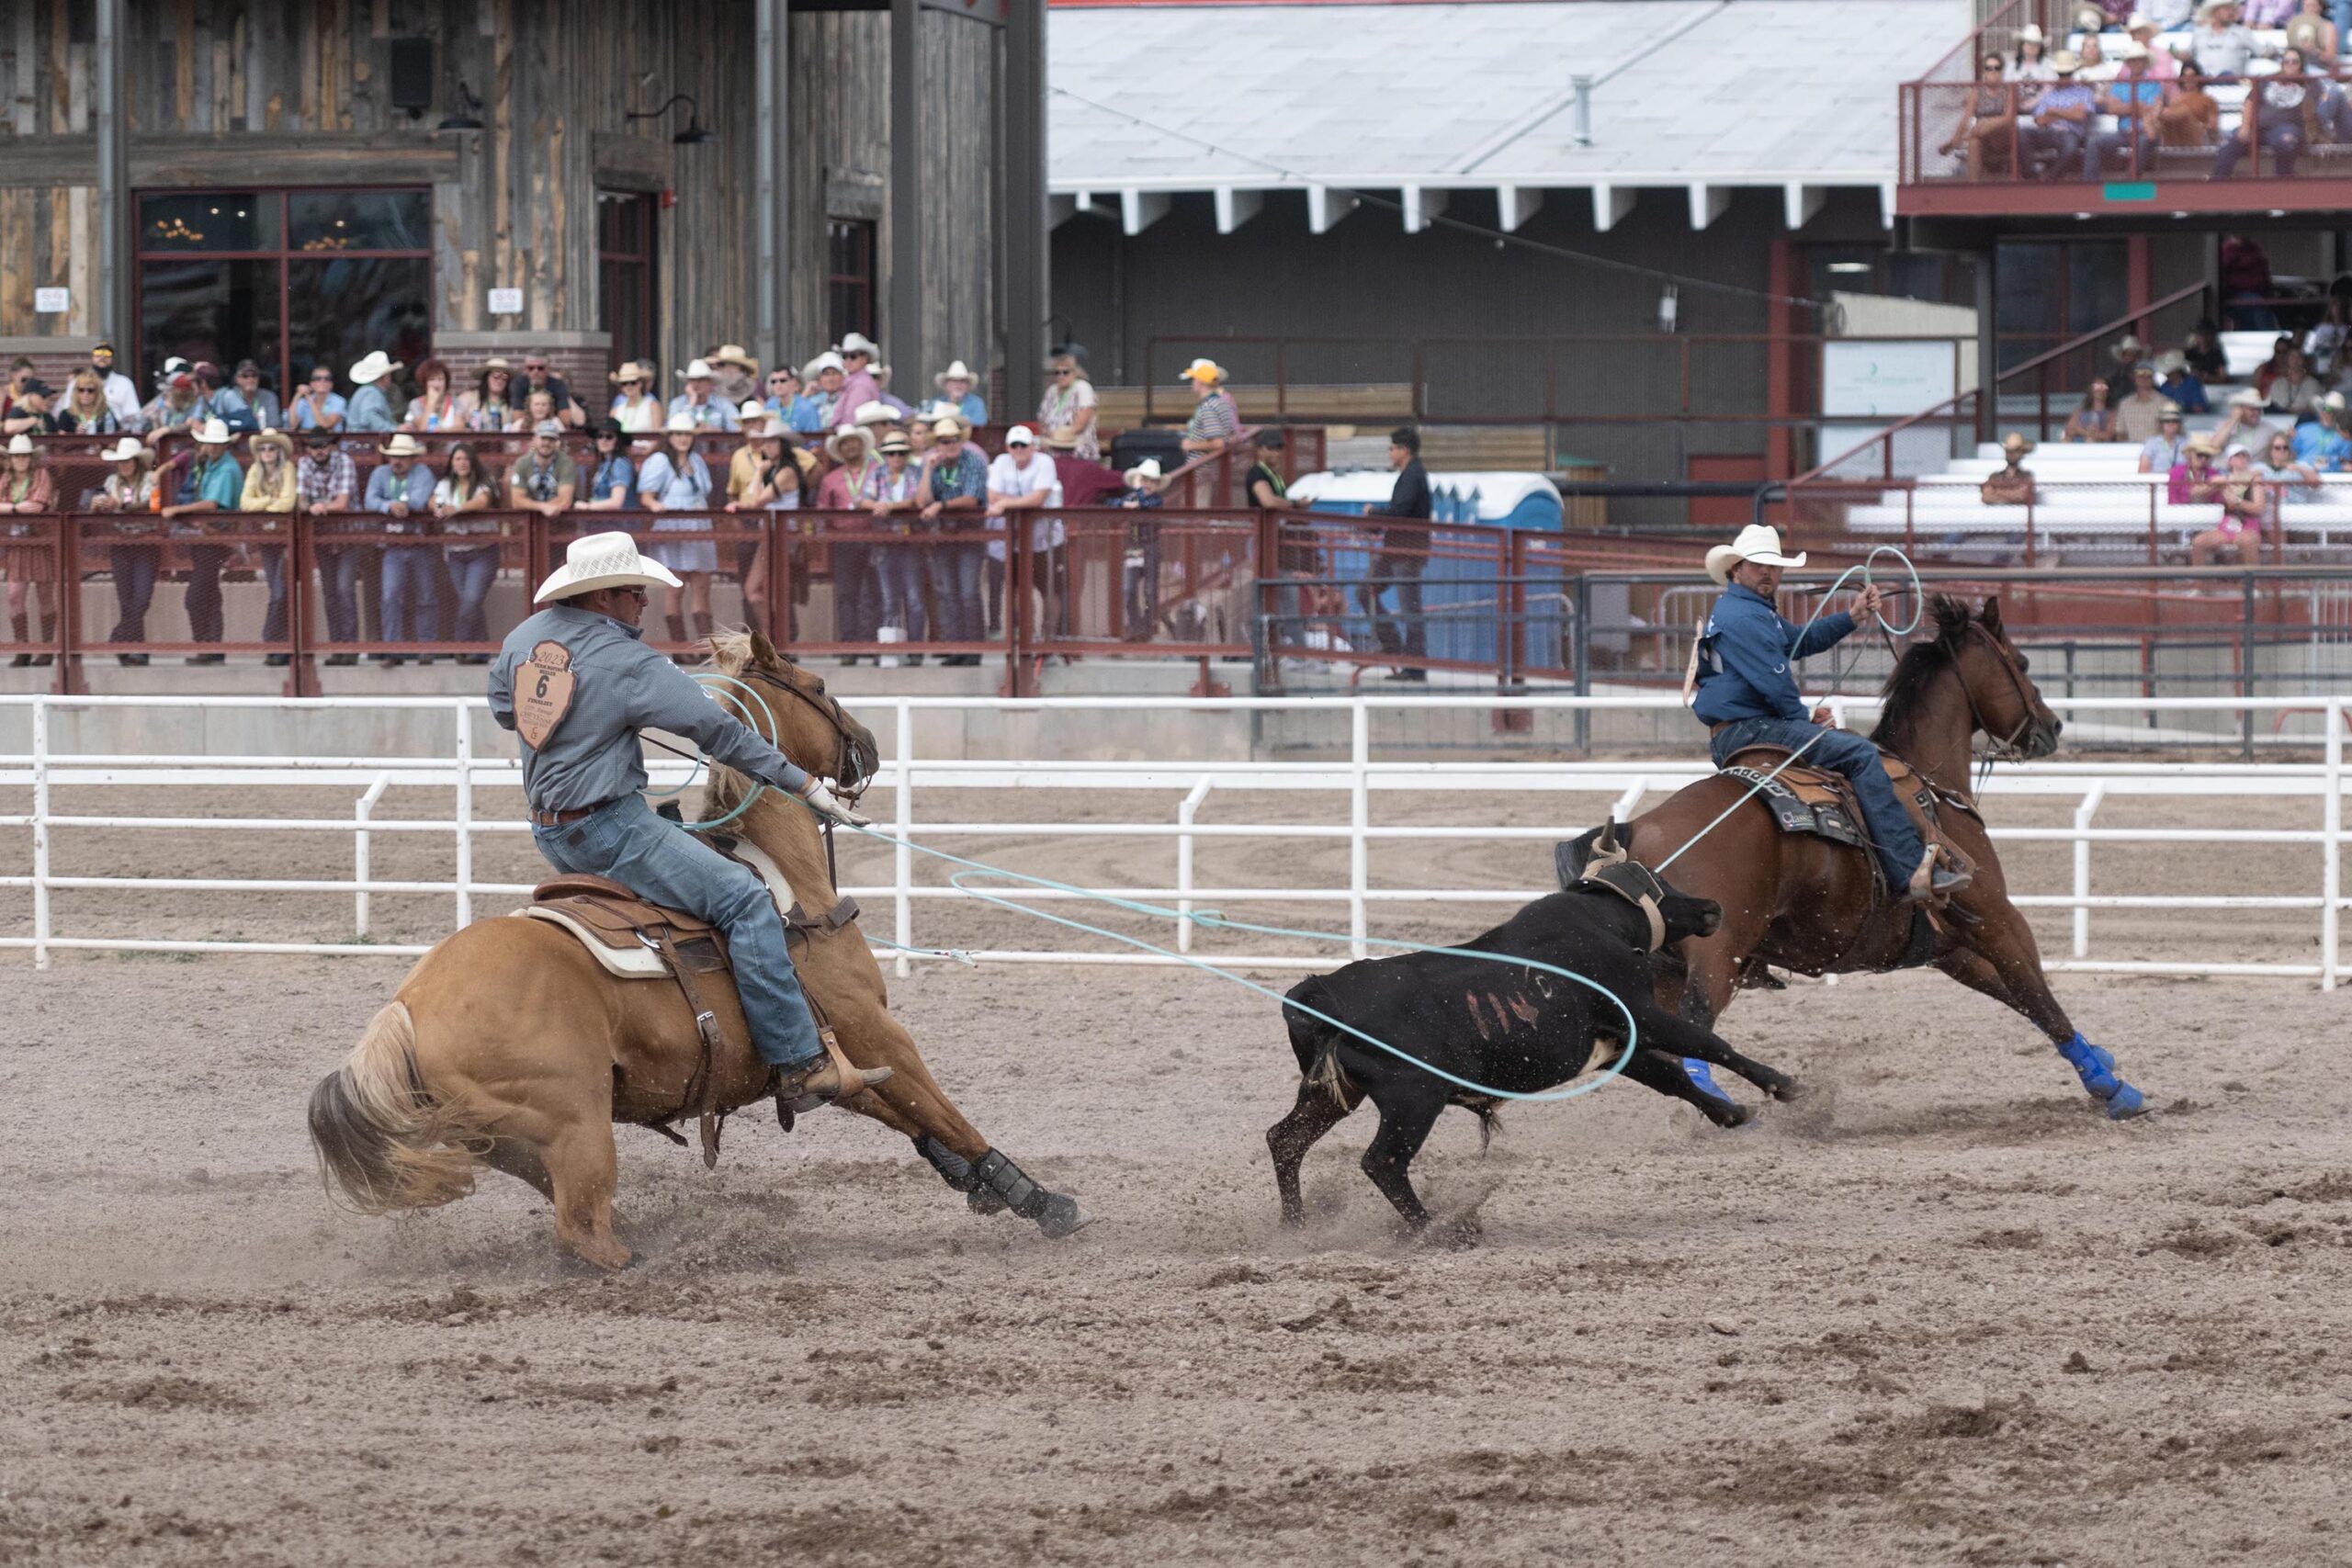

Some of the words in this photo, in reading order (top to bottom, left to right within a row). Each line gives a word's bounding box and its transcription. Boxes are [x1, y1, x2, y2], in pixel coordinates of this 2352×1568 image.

[538, 651, 565, 666] 2023
[536, 675, 549, 698] 6
[527, 698, 553, 707] FINALIST
